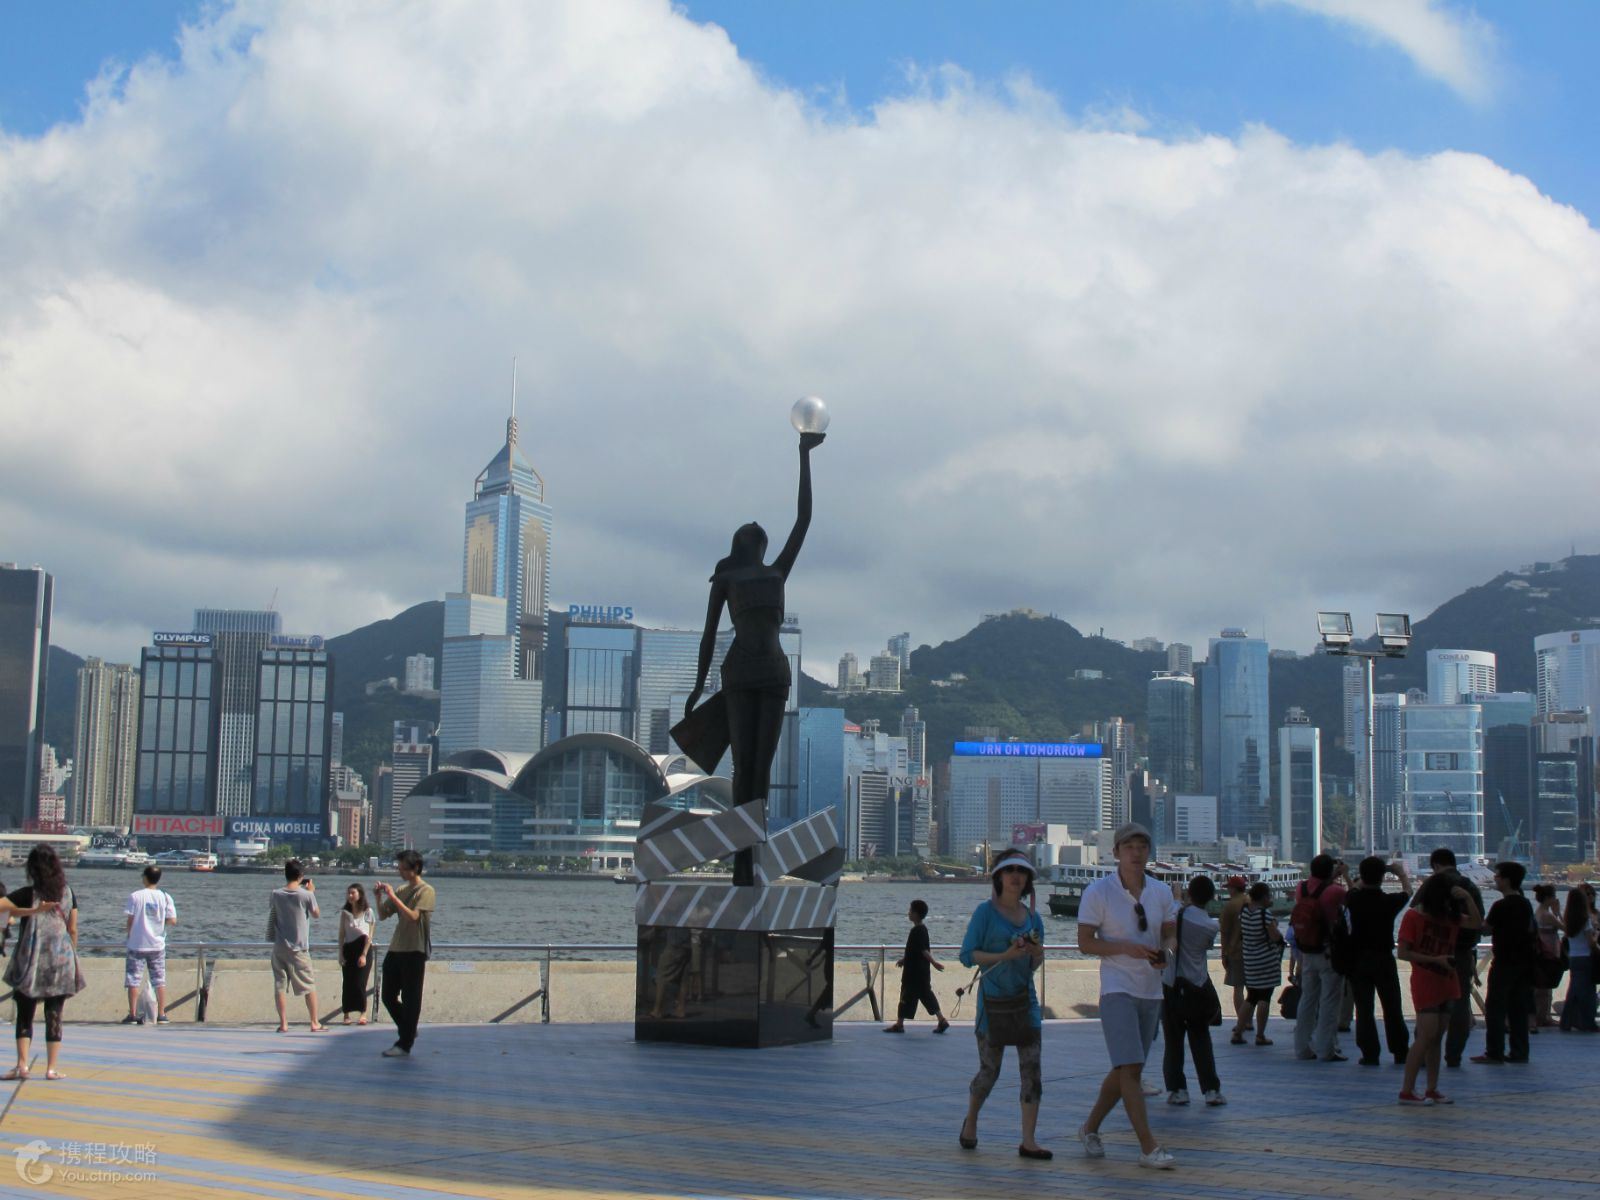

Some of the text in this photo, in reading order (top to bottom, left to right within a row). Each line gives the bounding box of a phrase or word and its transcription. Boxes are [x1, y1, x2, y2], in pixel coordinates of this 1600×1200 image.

[569, 604, 634, 621] PHILIPS
[154, 632, 210, 643] OLYMPUS
[1005, 744, 1020, 755] ON
[1023, 744, 1086, 756] TOMORROW
[890, 776, 912, 786] ING
[134, 816, 223, 833] HITACHI
[232, 821, 320, 834] CHINA MOBILE
[92, 836, 130, 846] DYNASTY
